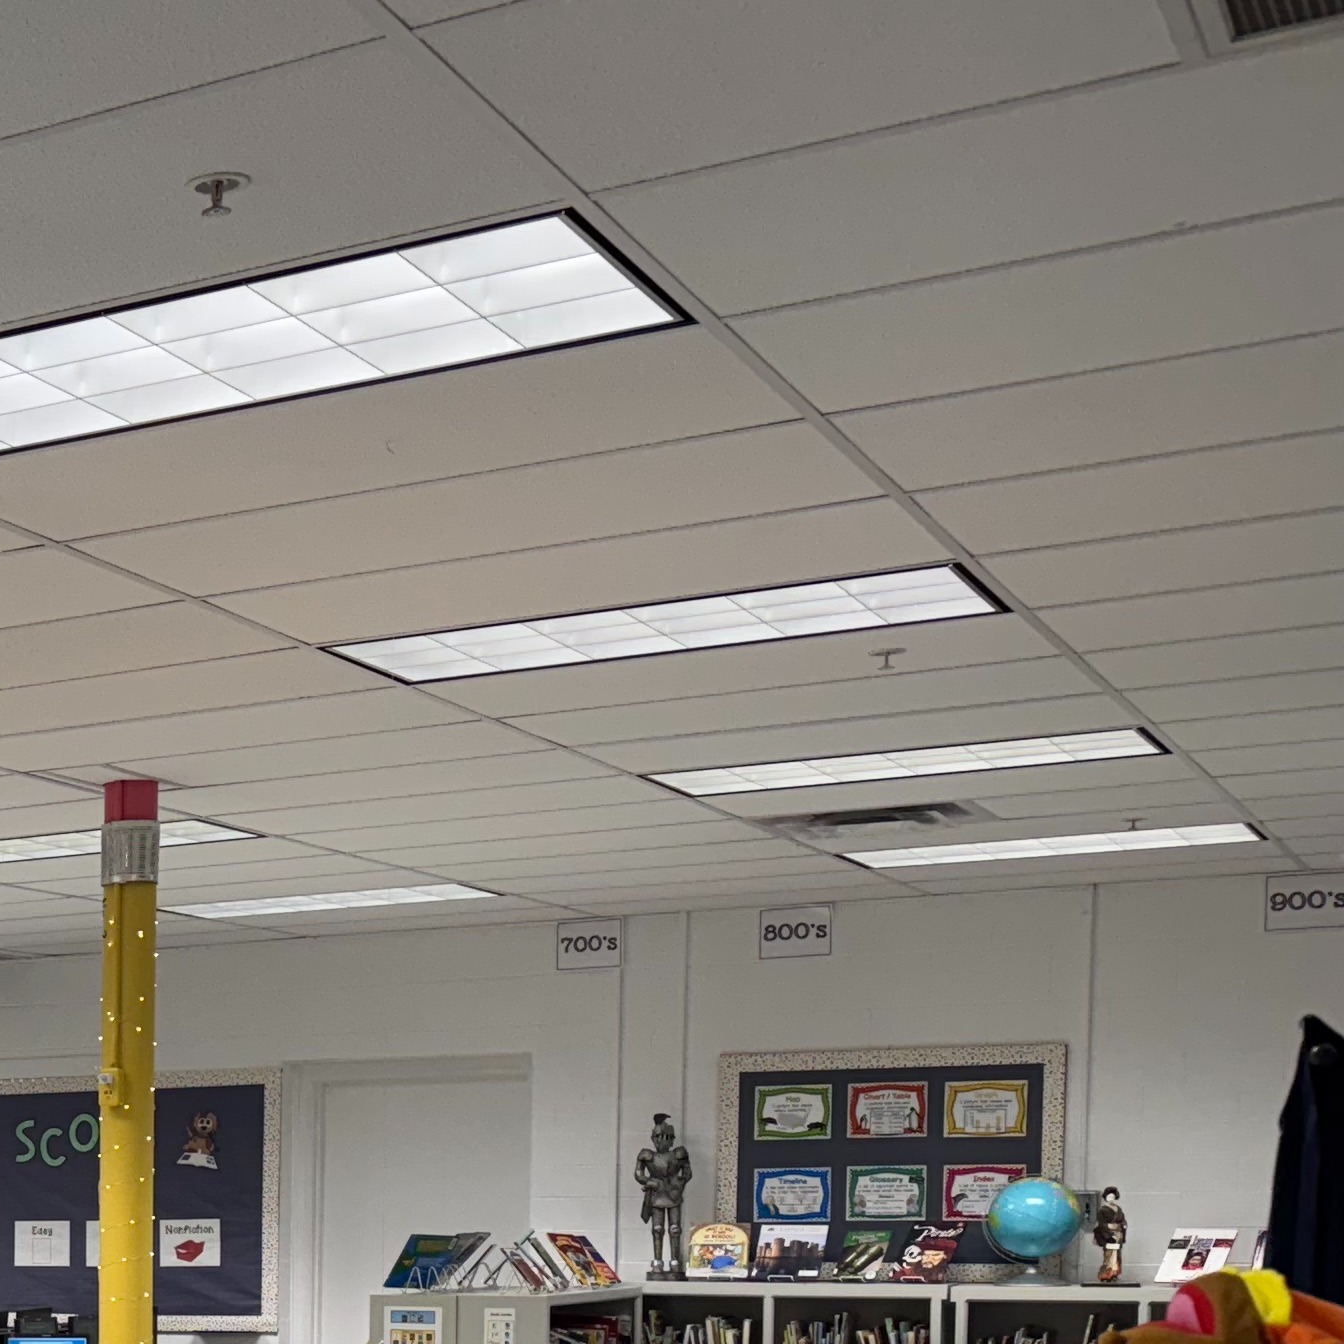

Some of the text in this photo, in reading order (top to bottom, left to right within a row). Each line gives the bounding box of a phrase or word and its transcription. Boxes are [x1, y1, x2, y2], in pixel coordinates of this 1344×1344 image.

[1270, 890, 1344, 911] 900's
[764, 922, 827, 942] 800's
[560, 935, 618, 953] 700's
